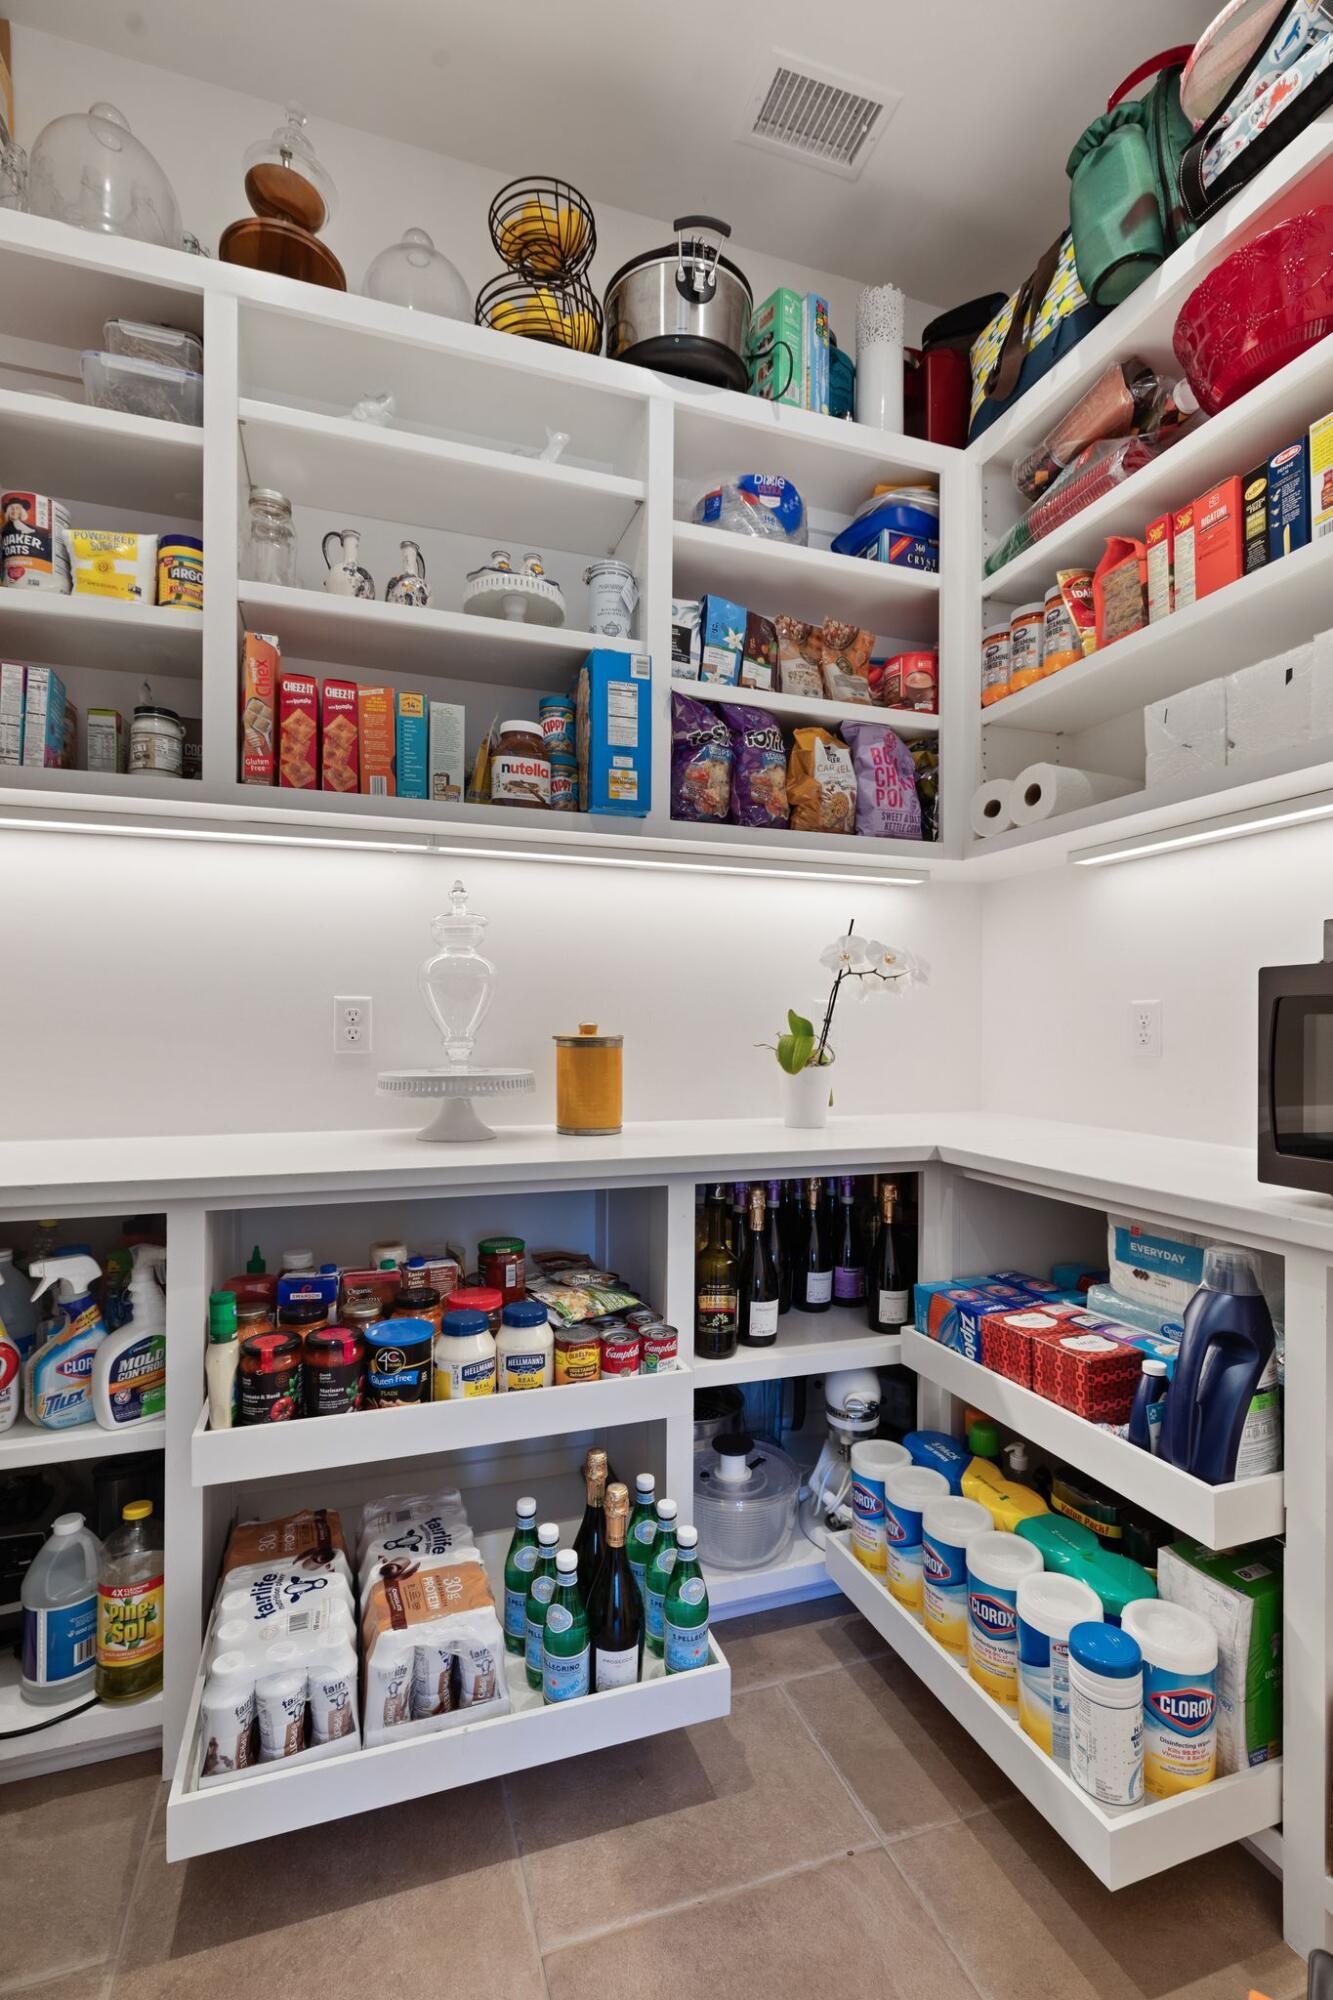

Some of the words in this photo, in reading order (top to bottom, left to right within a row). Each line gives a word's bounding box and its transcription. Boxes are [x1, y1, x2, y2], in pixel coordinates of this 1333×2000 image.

[754, 473, 785, 489] Dixie
[1200, 504, 1228, 527] RIGATONI
[3, 533, 42, 551] UAKER
[73, 531, 135, 546] POWDERED
[914, 543, 926, 553] 360
[907, 552, 937, 567] CRYST
[169, 566, 203, 583] ARGO
[255, 659, 272, 697] Chex
[282, 680, 315, 695] CHEEZ-IT
[325, 686, 356, 700] CHEEZ-IT
[245, 757, 270, 767] Gluten
[250, 764, 267, 773] Free
[501, 761, 550, 779] nutella
[881, 810, 903, 821] SWEET
[1129, 1241, 1187, 1266] EVERYDAY
[959, 1311, 977, 1360] Ziplo
[63, 1356, 93, 1375] CLOR
[118, 1348, 165, 1373] MOLD
[378, 1351, 400, 1372] 4C
[463, 1360, 495, 1377] HELLMANN
[371, 1375, 394, 1386] Gluten
[394, 1374, 413, 1383] Free
[42, 1387, 85, 1419] TILEX
[1059, 1502, 1083, 1522] Value
[425, 1516, 453, 1556] fairlife
[111, 1588, 123, 1598] 4X
[250, 1572, 279, 1620] fairlife
[423, 1576, 441, 1611] PROTEIN
[970, 1596, 1016, 1628] CLOROX
[111, 1617, 146, 1643] Sol
[602, 1656, 634, 1665] PROSECCO
[1160, 1694, 1214, 1719] CLOROX
[1159, 1736, 1197, 1749] Disinfecting
